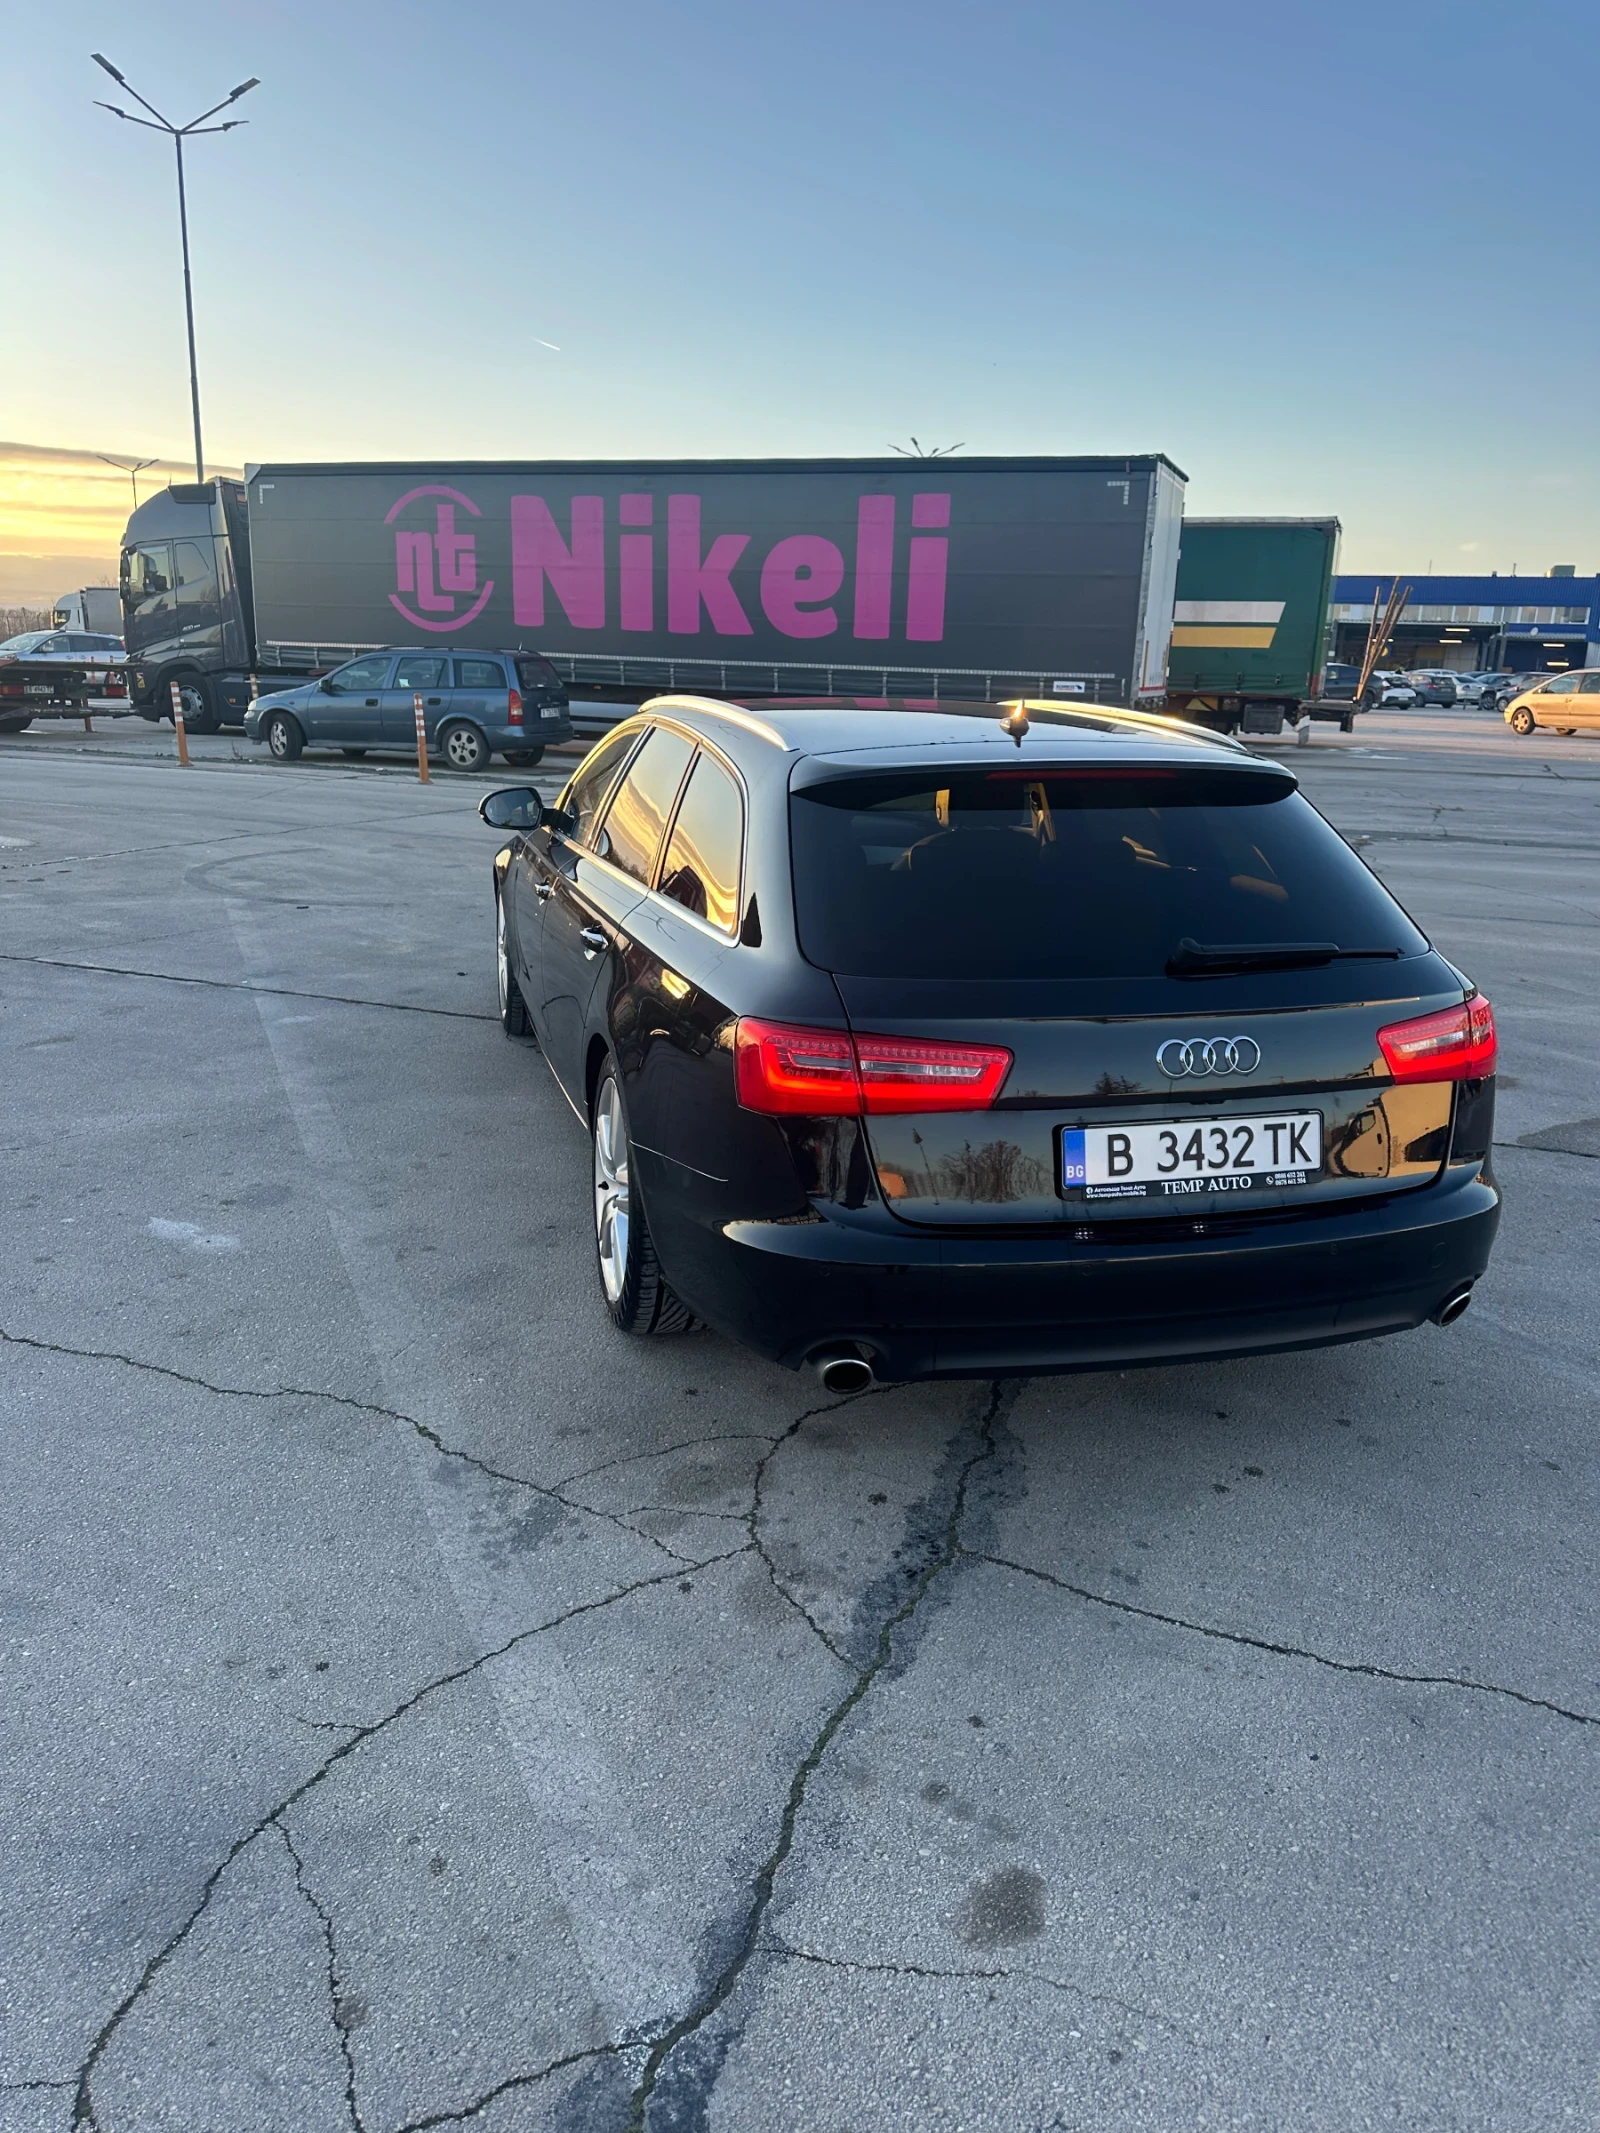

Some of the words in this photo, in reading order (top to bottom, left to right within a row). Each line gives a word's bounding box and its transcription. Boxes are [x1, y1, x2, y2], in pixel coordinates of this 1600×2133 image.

[510, 493, 951, 642] Nikeli
[1107, 1132, 1134, 1177] B
[1157, 1125, 1255, 1173] 3432
[1264, 1120, 1312, 1165] TK
[1066, 1165, 1085, 1179] BG
[1161, 1179, 1204, 1195] TEMP
[1208, 1175, 1252, 1191] AUTO
